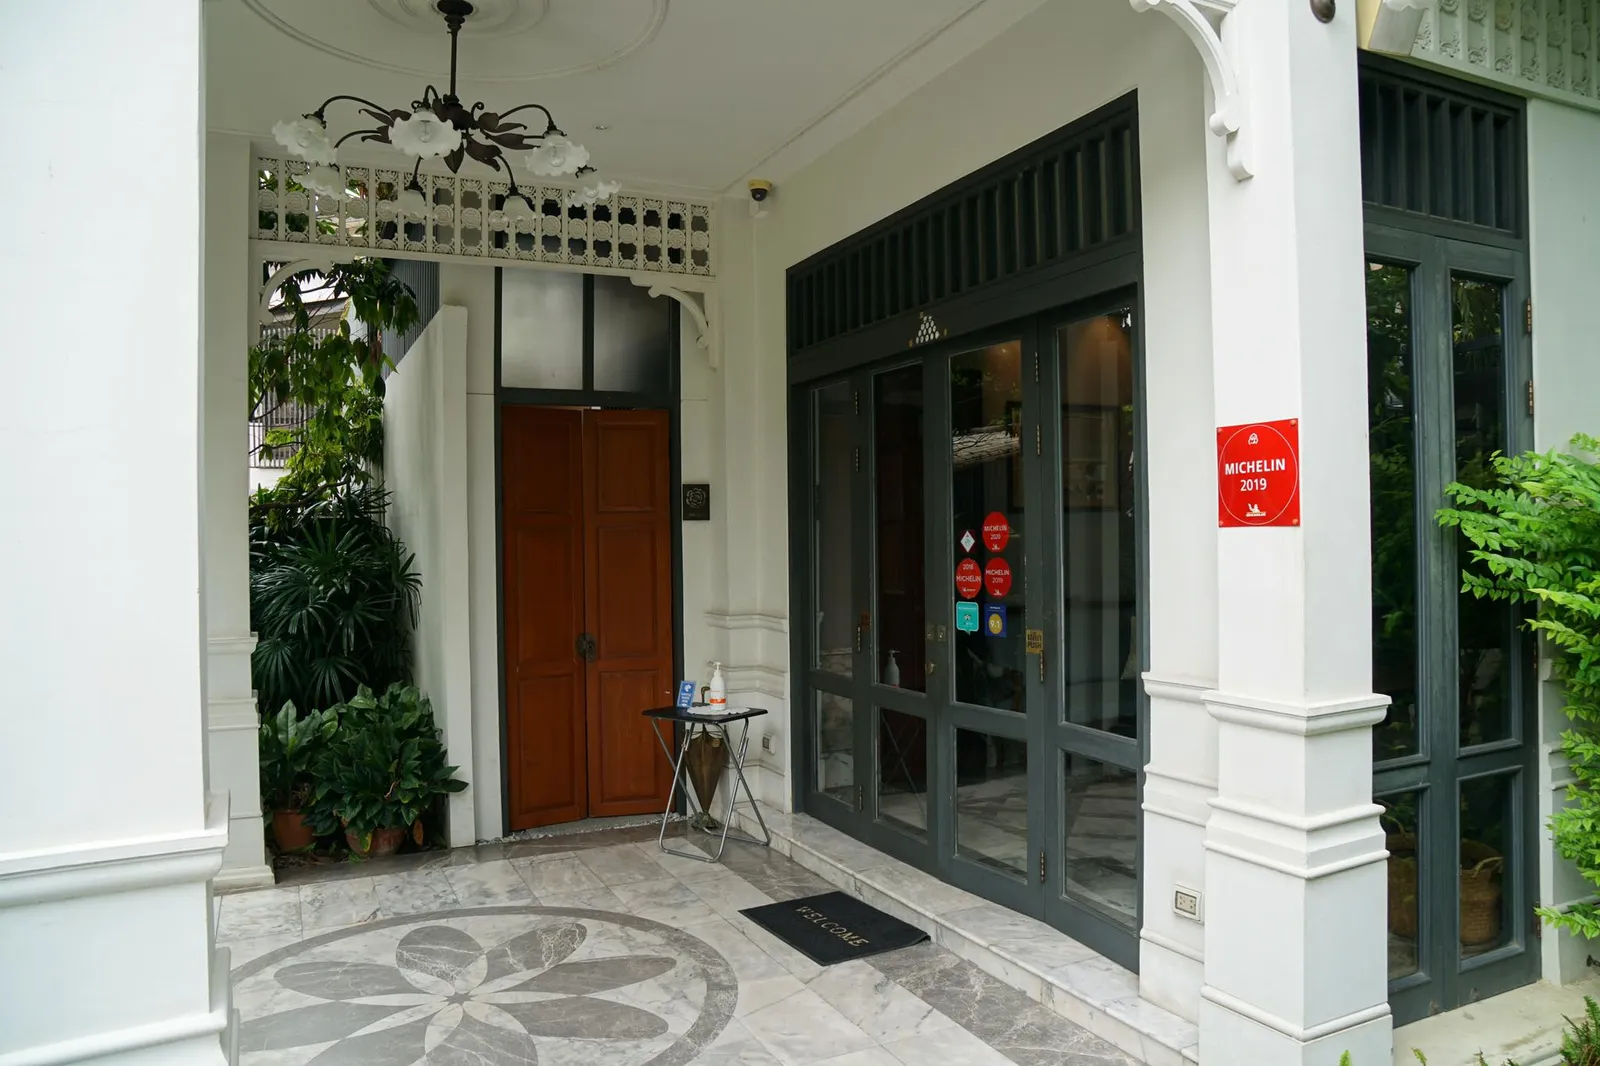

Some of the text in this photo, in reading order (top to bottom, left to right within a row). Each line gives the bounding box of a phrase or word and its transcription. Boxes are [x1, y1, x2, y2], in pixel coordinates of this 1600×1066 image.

[1224, 458, 1286, 475] MICHELIN
[1240, 478, 1267, 491] 2019
[990, 620, 1001, 628] 9.1
[1027, 641, 1042, 649] PUSH
[795, 906, 869, 947] WELCOME
